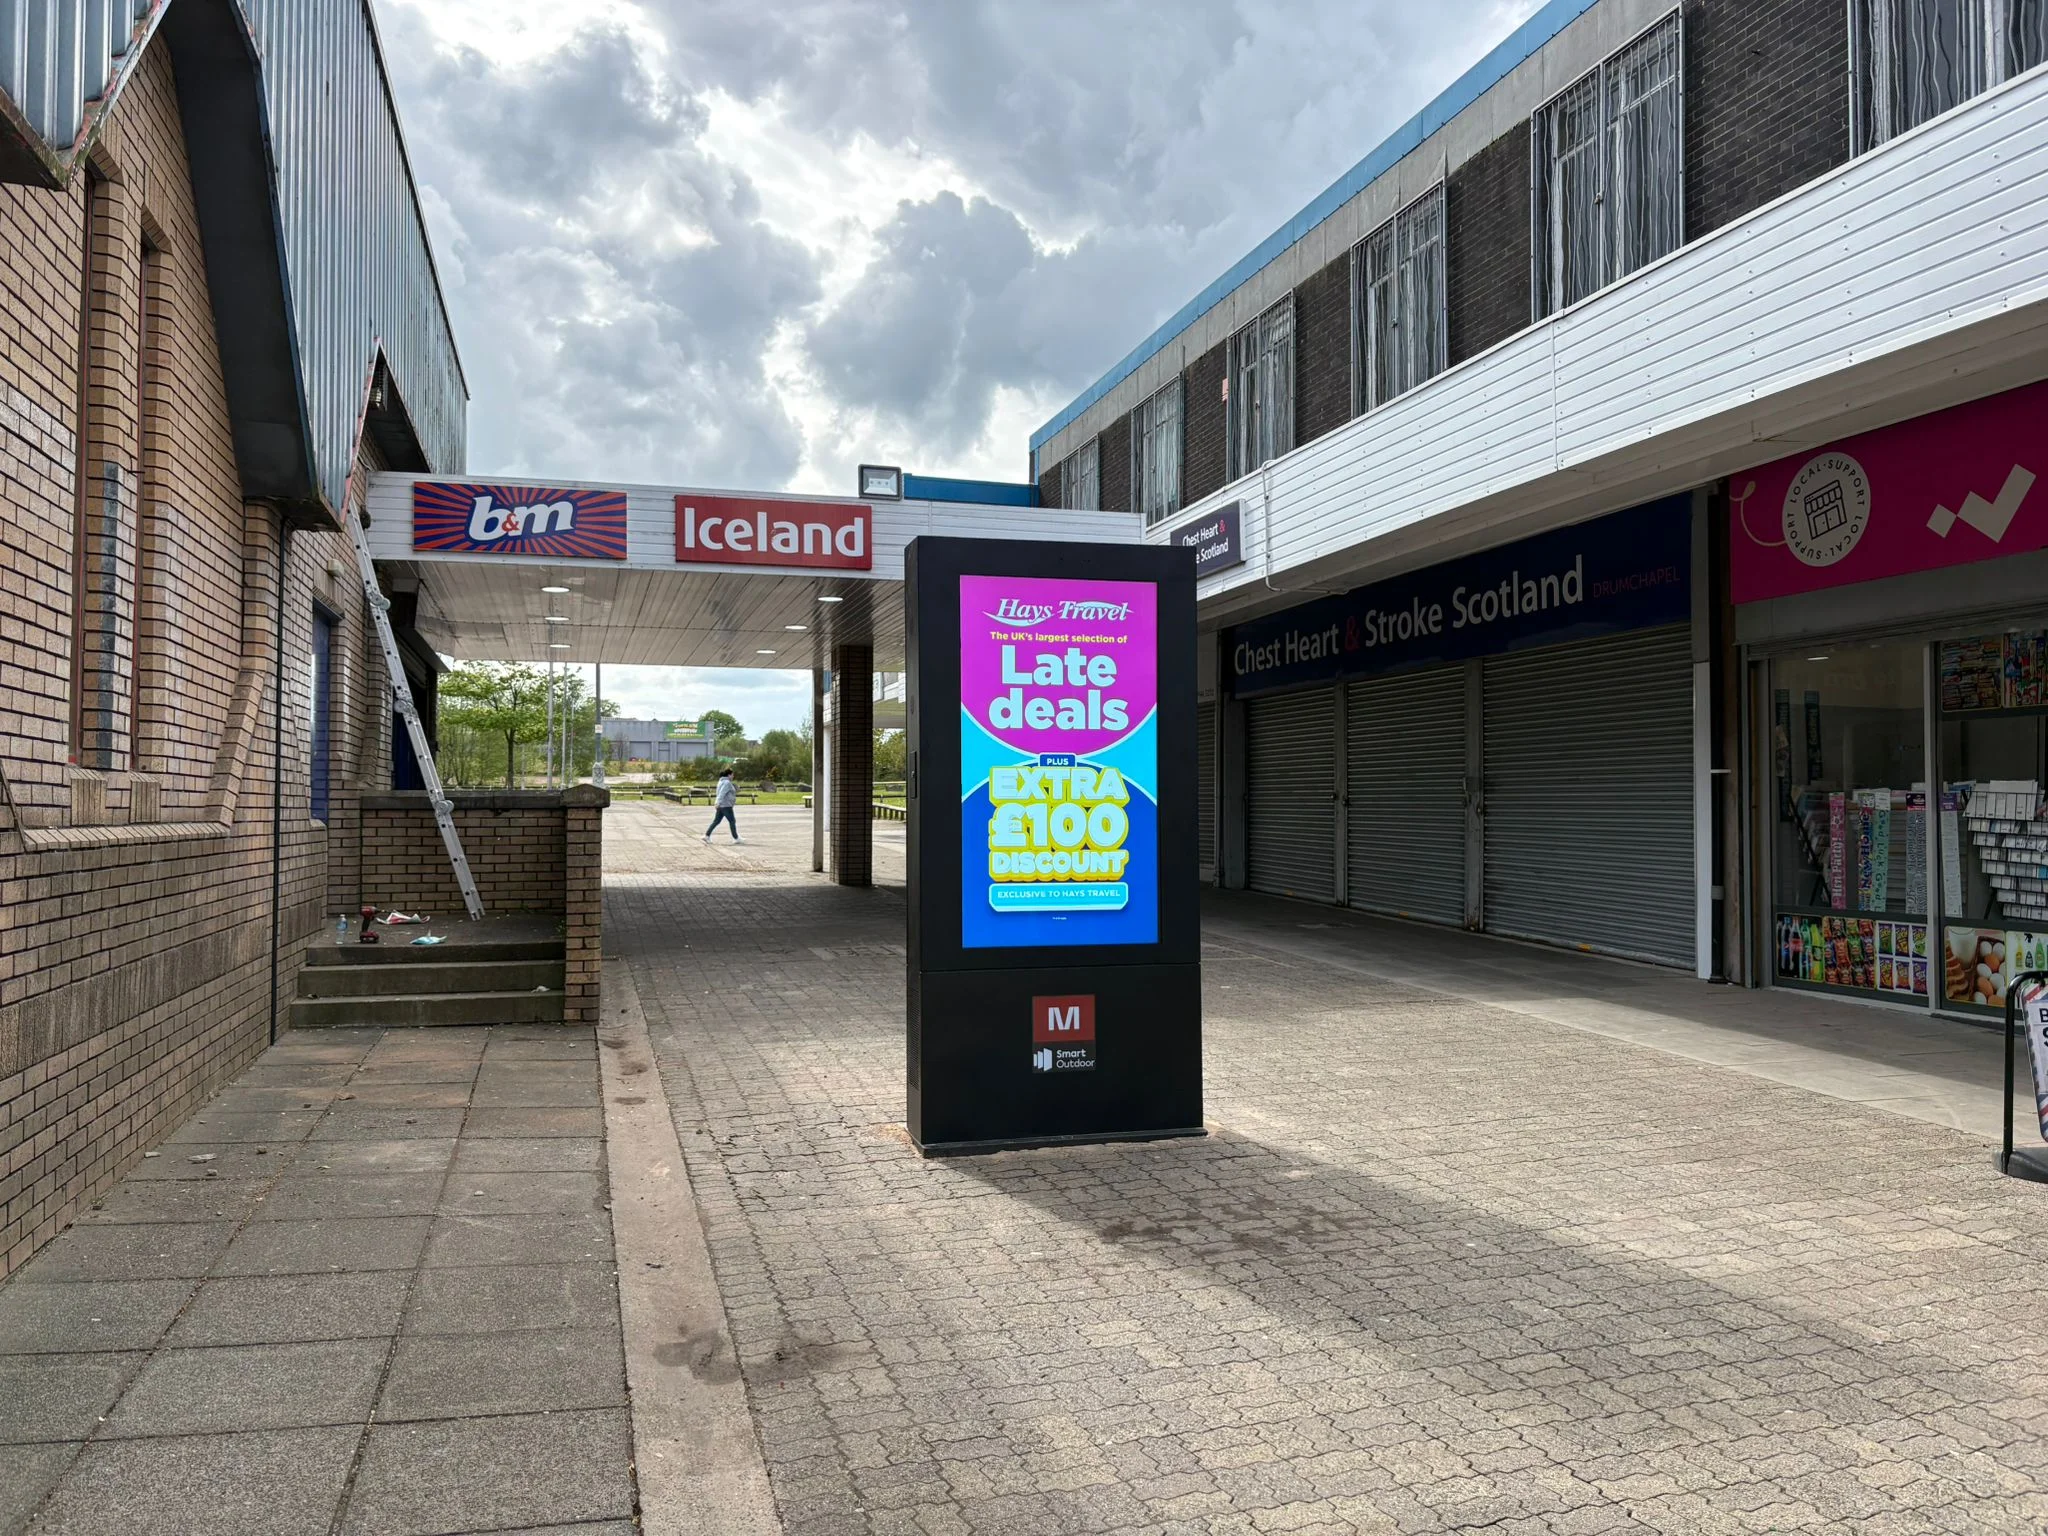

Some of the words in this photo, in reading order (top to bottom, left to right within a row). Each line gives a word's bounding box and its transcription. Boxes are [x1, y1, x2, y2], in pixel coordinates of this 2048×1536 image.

[684, 506, 865, 558] Iceland
[1200, 523, 1219, 542] Heart
[1200, 537, 1229, 562] Scotland
[996, 598, 1053, 624] Hays
[1058, 600, 1129, 622] Travel
[1233, 637, 1282, 676] Chest
[1284, 623, 1339, 666] Heart
[1344, 615, 1361, 652] &
[1364, 596, 1443, 648] Stroke
[1452, 554, 1584, 630] Scotland
[1592, 565, 1681, 599] DRUMCHAPEL
[990, 631, 1009, 641] The
[1011, 632, 1034, 642] UK's
[1035, 633, 1069, 643] largest
[1071, 634, 1115, 643] selection
[1117, 635, 1128, 643] of
[1001, 644, 1118, 687] Late
[988, 687, 1129, 731] deals
[1046, 757, 1069, 766] PLUS
[990, 767, 1128, 801] EXTRA
[990, 802, 1127, 848] £100
[991, 850, 1127, 875] DISCOUNT
[997, 890, 1046, 899] EXCLUSIVE
[1049, 890, 1060, 898] TO
[1062, 889, 1085, 897] HAYS
[1088, 889, 1121, 897] TRAVEL
[1056, 1048, 1087, 1059] Smart
[1056, 1059, 1096, 1069] Outdoor
